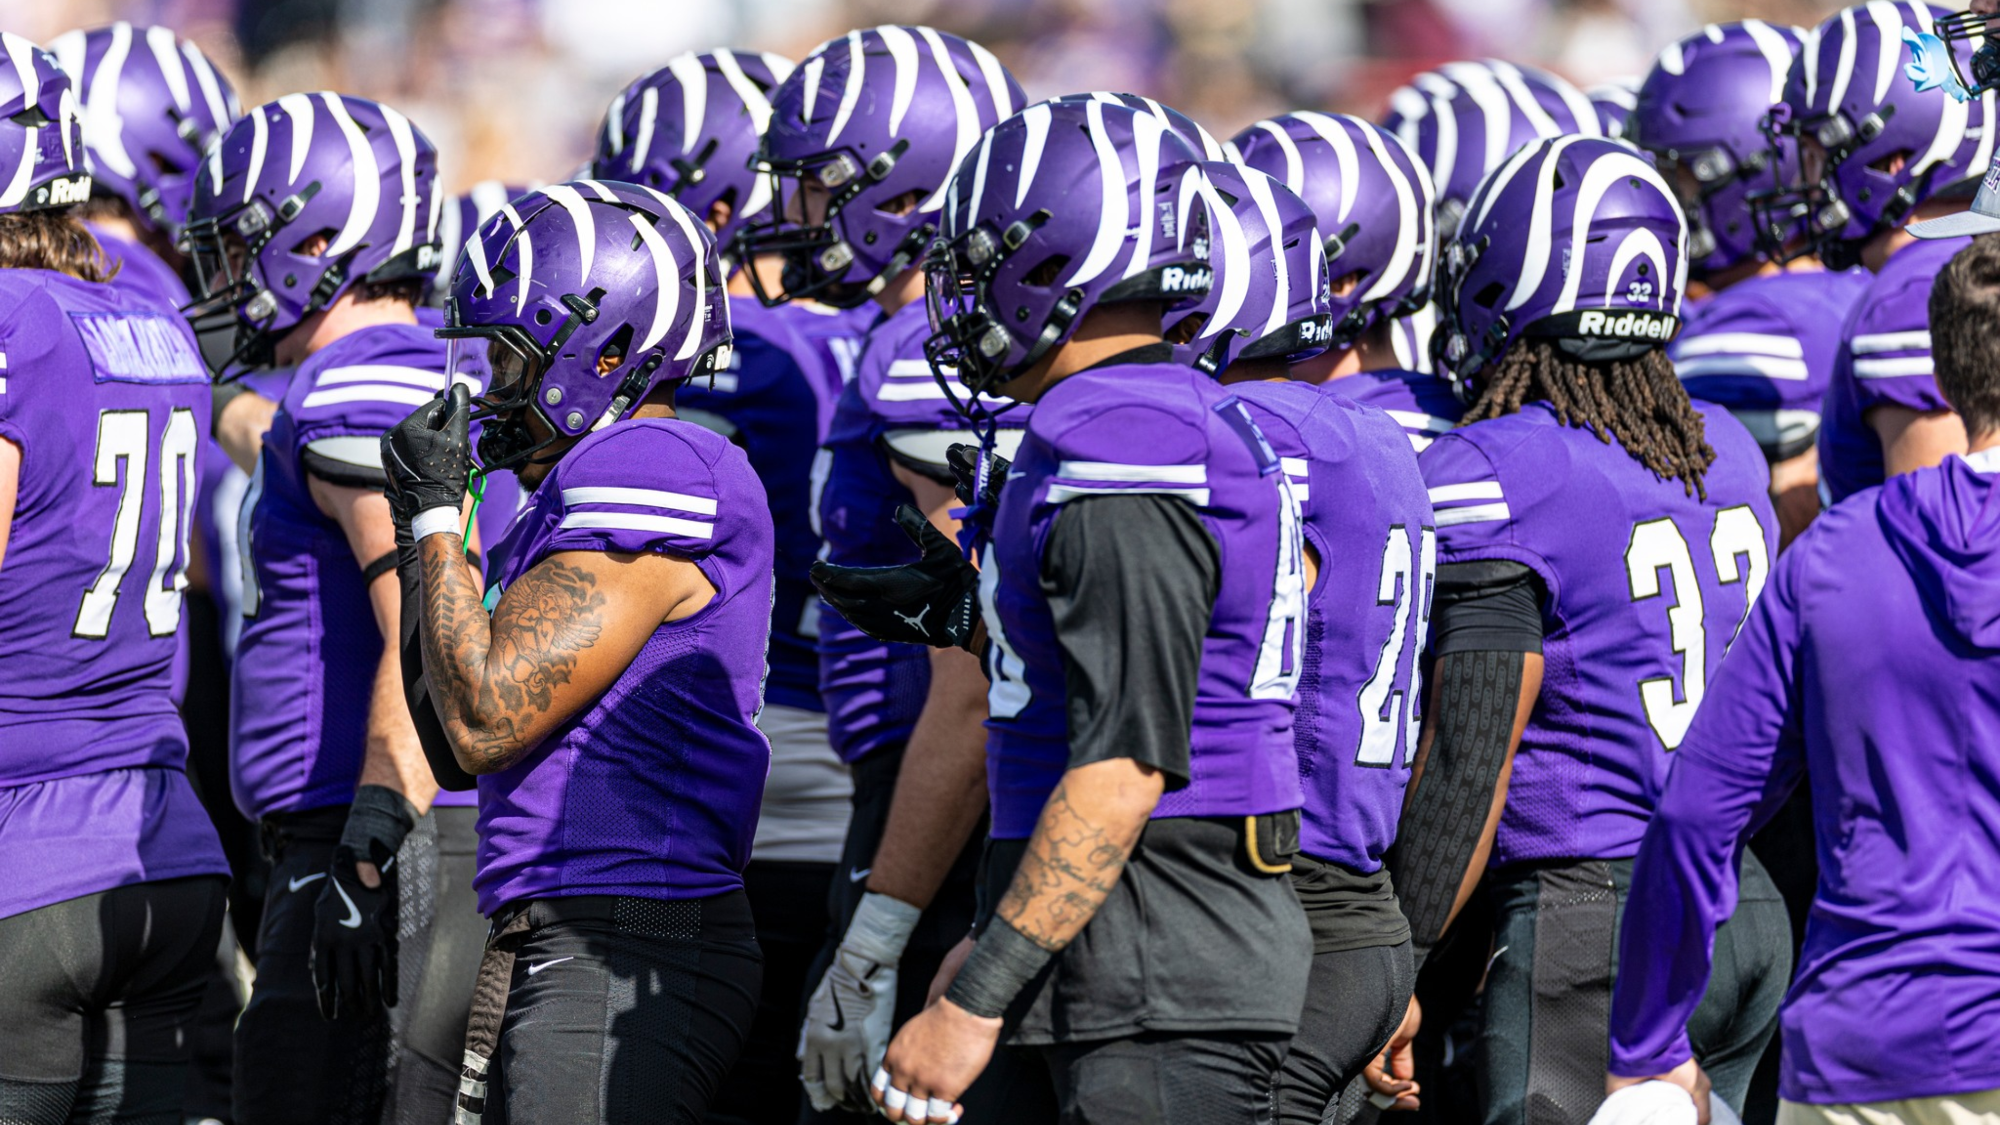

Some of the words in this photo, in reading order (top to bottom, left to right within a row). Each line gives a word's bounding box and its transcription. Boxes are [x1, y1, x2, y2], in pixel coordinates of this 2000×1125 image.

[49, 175, 92, 205] Ridd
[1161, 266, 1215, 292] Ridd
[1626, 281, 1652, 303] 32
[1578, 310, 1676, 340] Riddell
[70, 404, 198, 640] 70
